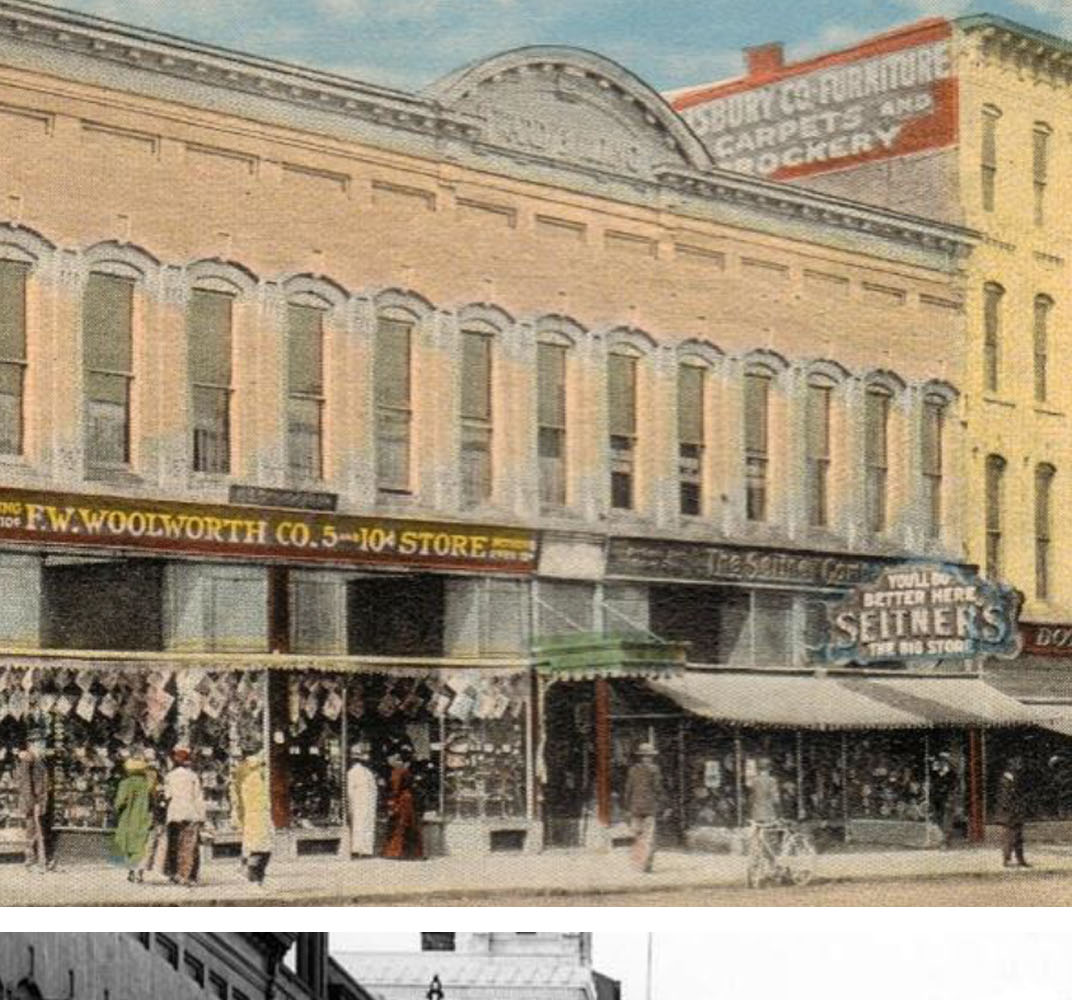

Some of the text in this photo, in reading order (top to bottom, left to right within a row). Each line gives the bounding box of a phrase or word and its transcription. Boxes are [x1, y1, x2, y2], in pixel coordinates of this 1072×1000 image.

[685, 91, 773, 135] SBURY
[819, 42, 952, 104] FURNITURE
[715, 93, 935, 158] CARPETS AND
[719, 124, 904, 175] ROCKERY
[276, 521, 319, 548] CO.
[398, 530, 489, 558] STORE
[863, 590, 926, 608] BETTER
[870, 642, 895, 657] THE
[928, 639, 976, 654] STORE
